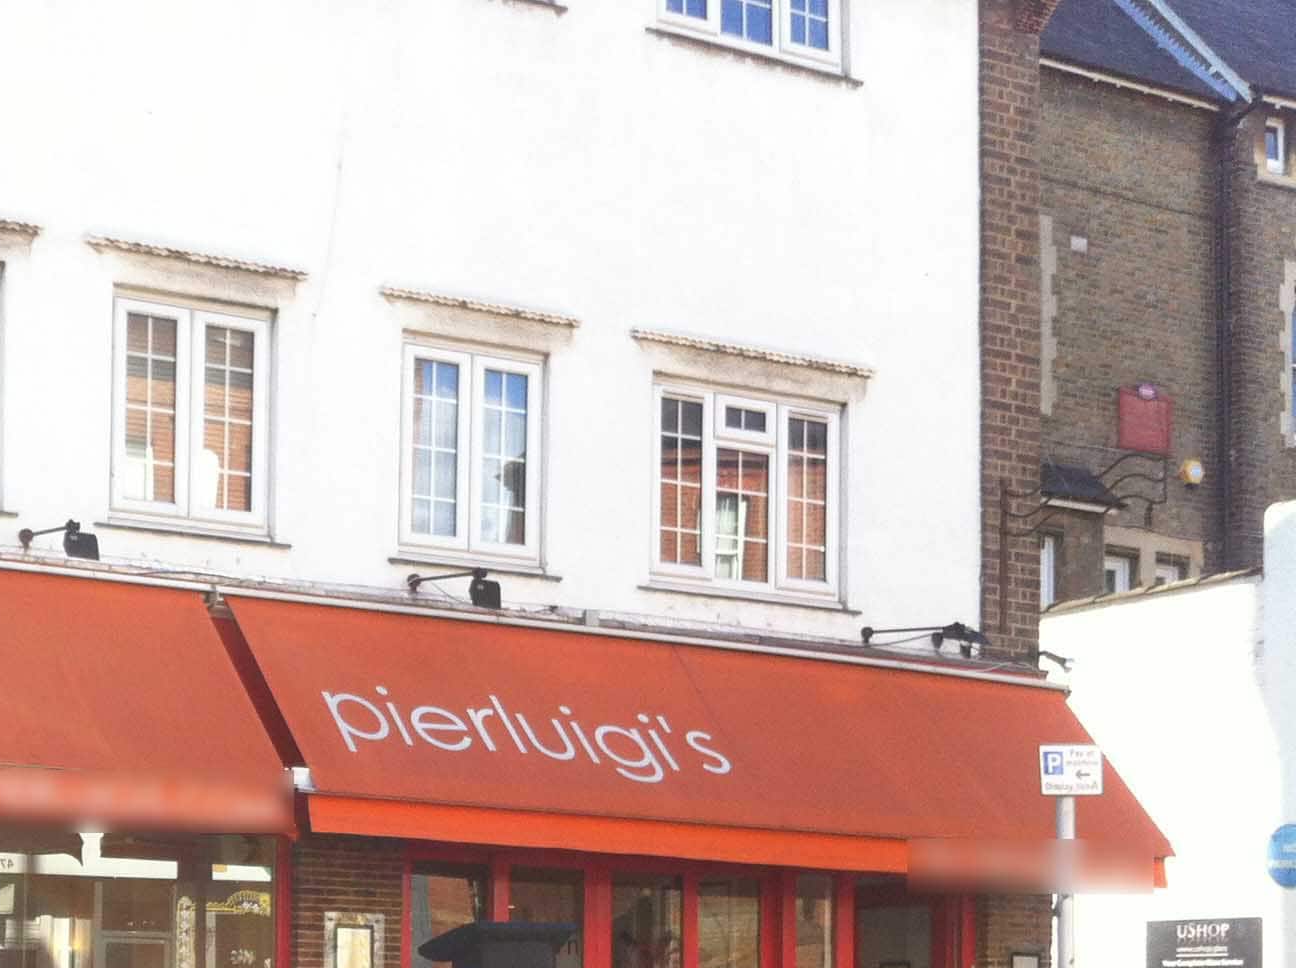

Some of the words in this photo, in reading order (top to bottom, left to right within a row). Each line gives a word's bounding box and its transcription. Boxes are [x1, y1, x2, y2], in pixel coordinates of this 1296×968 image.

[321, 685, 733, 784] pierluigi's
[1047, 753, 1063, 774] P
[1175, 922, 1231, 939] USHOP
